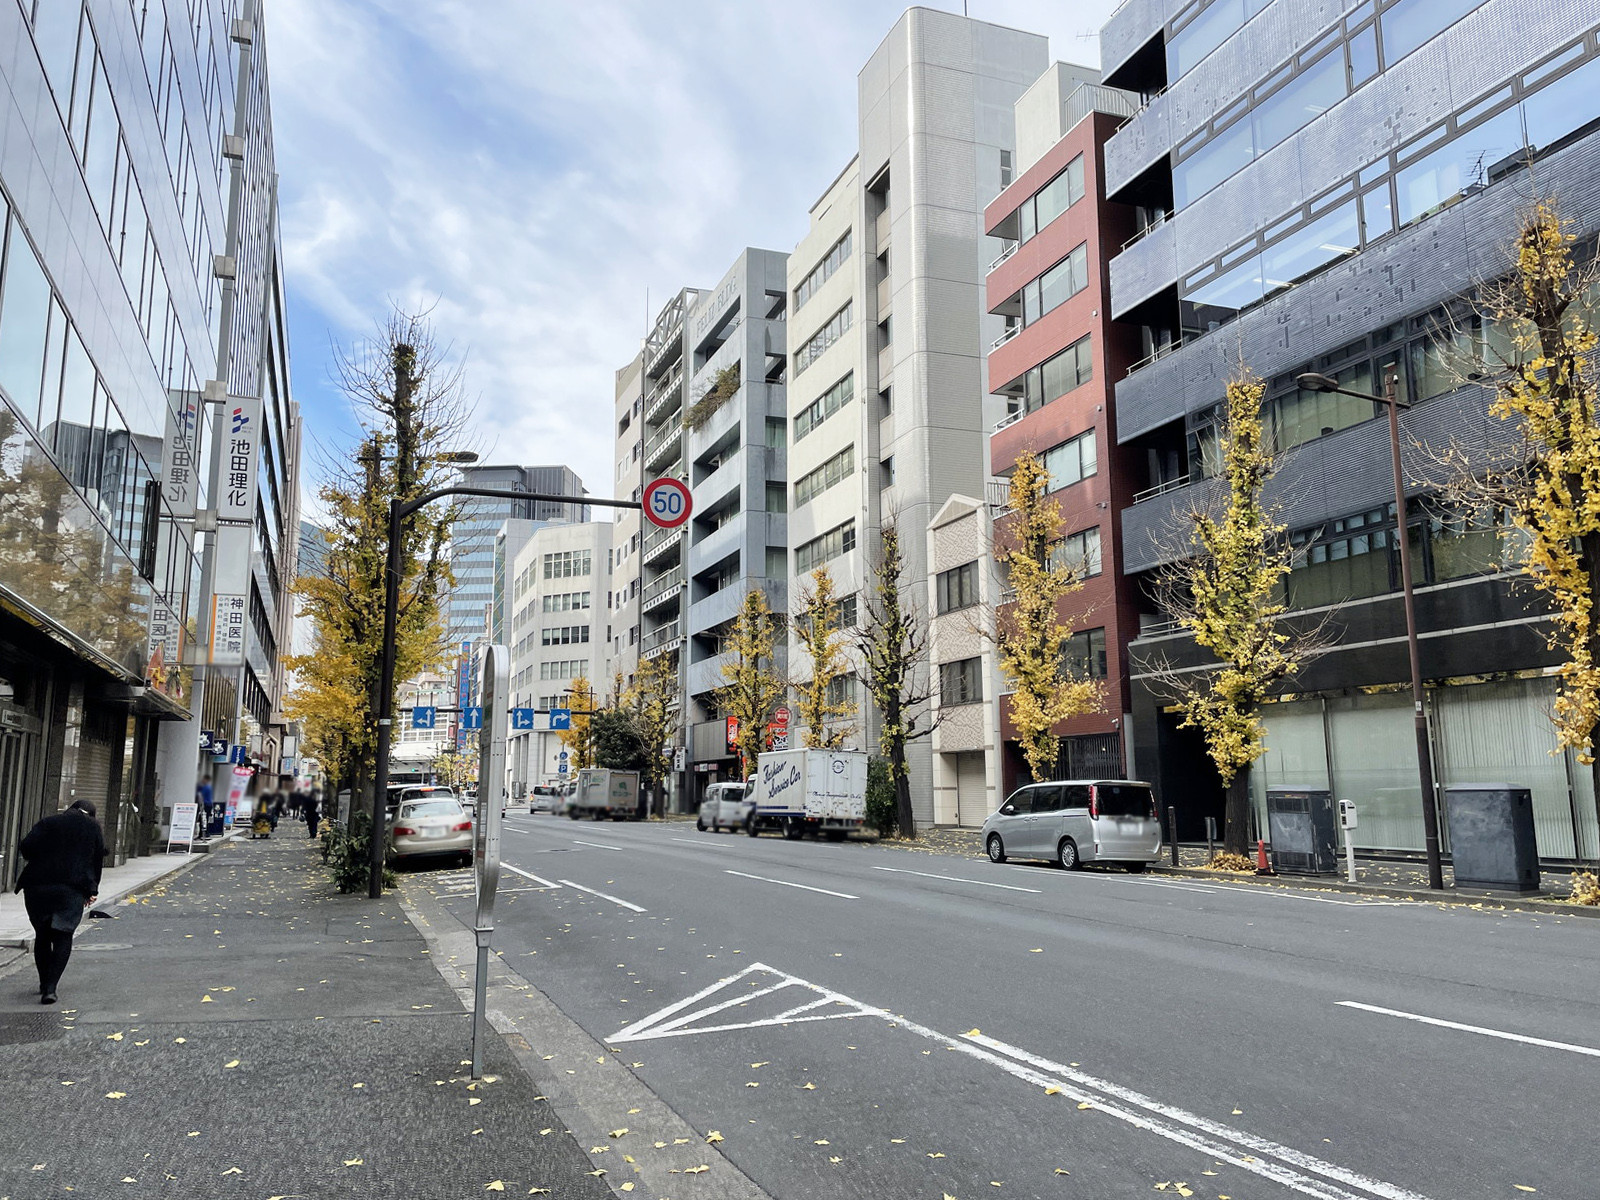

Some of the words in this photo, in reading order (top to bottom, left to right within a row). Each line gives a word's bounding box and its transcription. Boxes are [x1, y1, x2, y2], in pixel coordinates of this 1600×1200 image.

[228, 438, 250, 507] 池田理化
[654, 490, 682, 515] 50
[228, 597, 244, 654] 神田医院
[789, 765, 801, 786] Car
